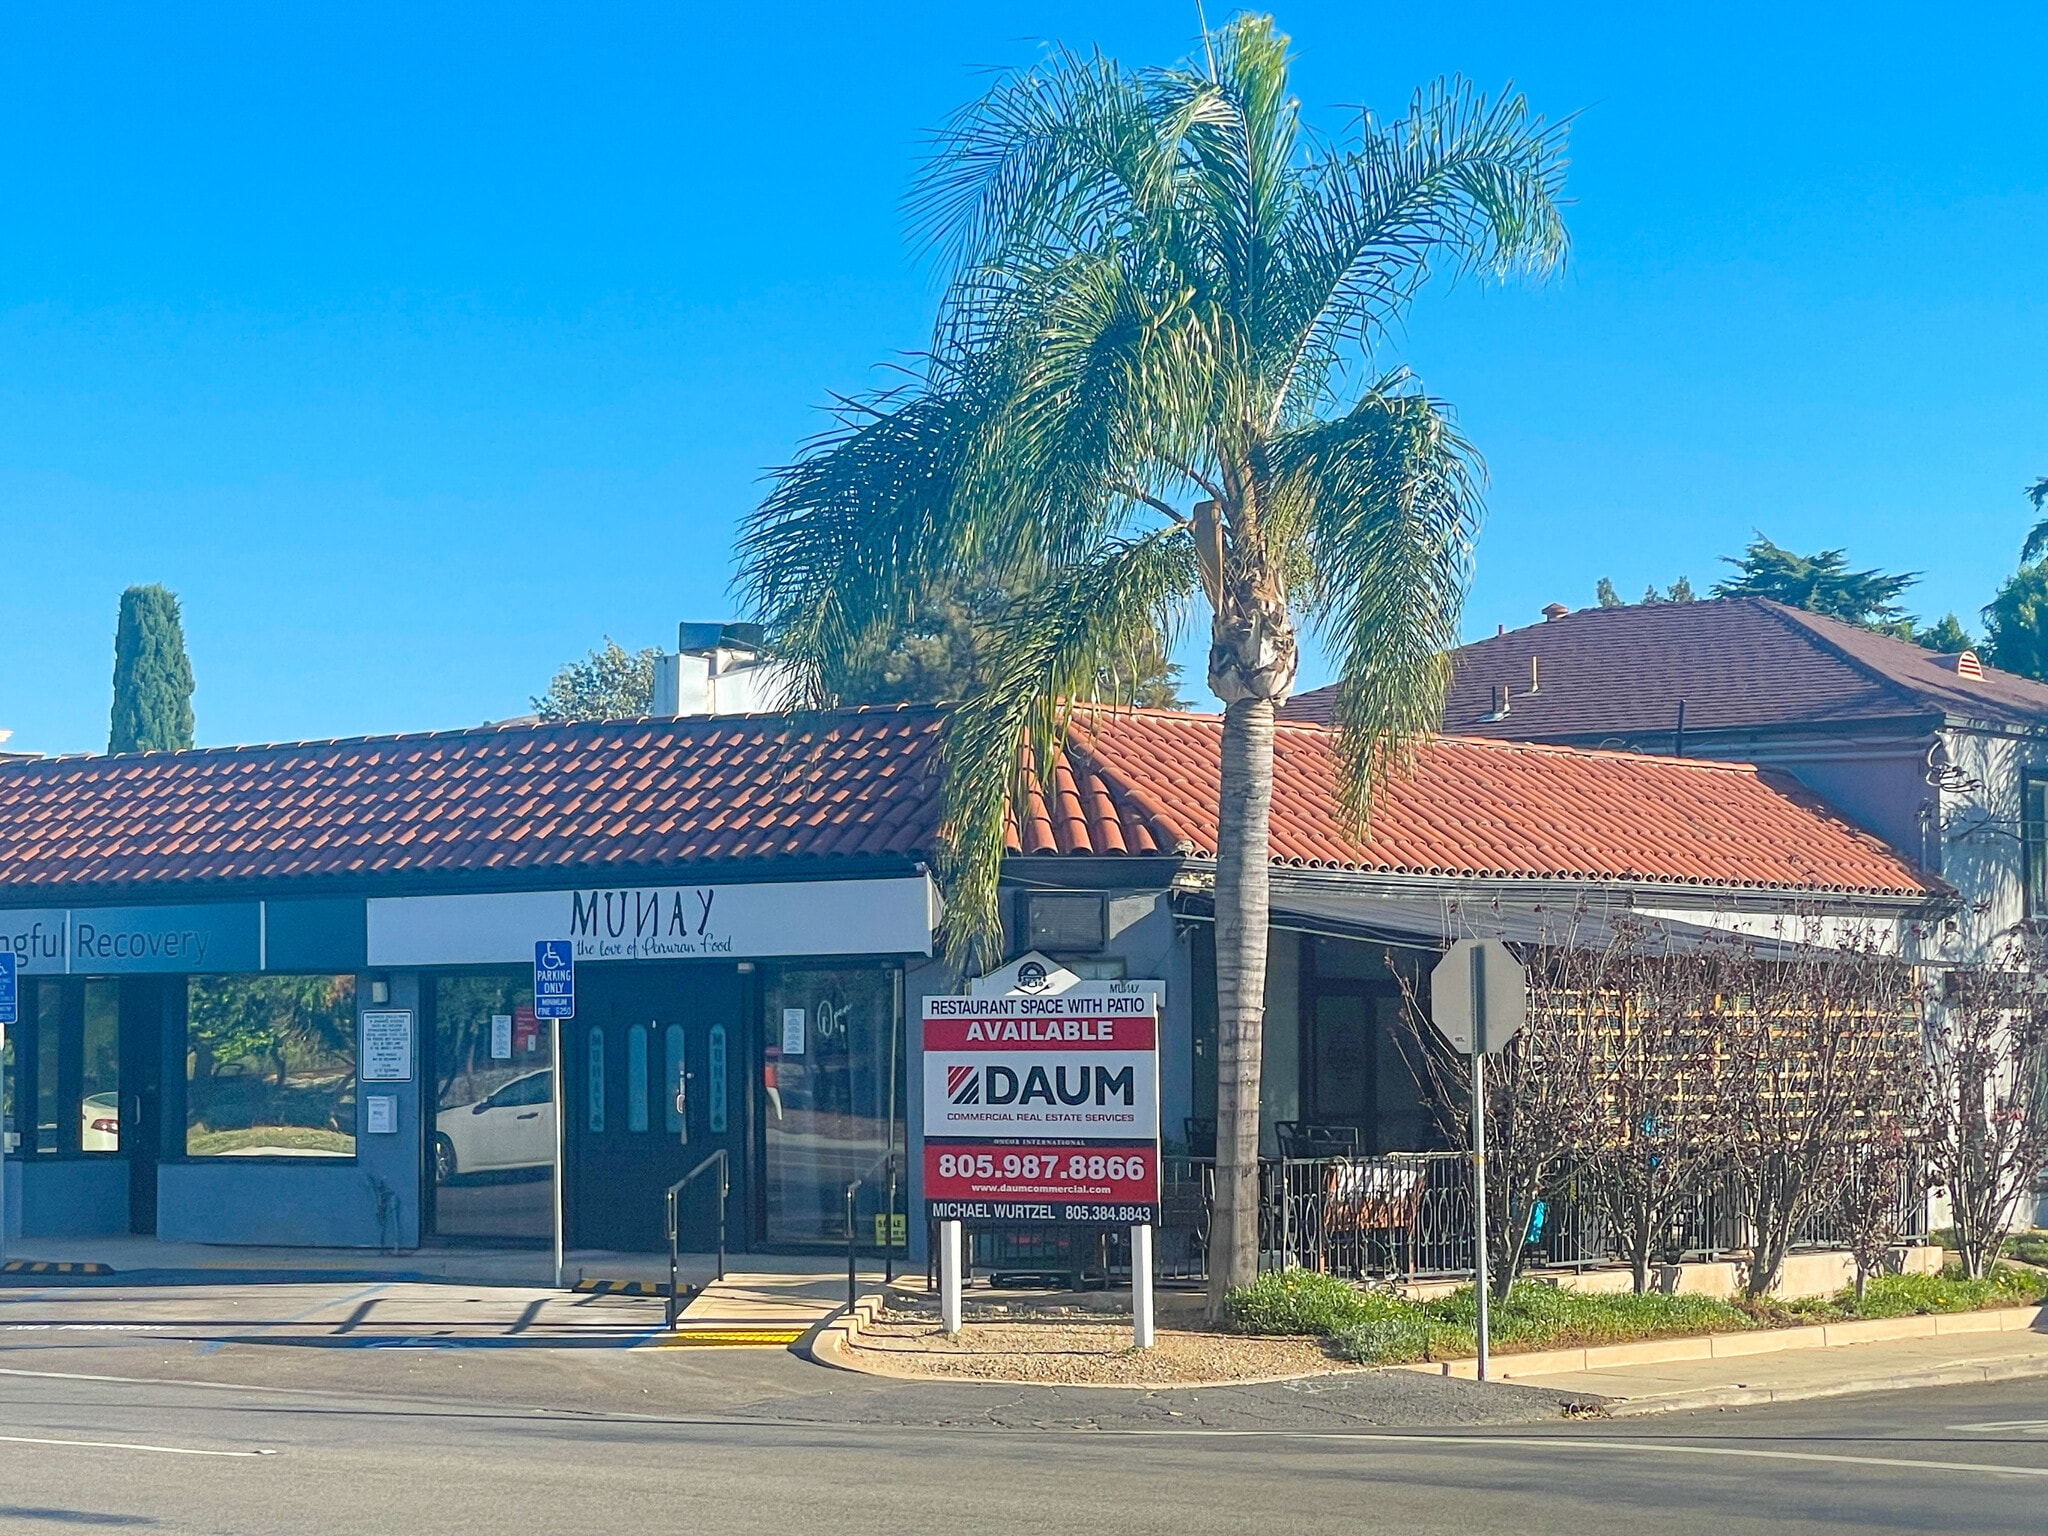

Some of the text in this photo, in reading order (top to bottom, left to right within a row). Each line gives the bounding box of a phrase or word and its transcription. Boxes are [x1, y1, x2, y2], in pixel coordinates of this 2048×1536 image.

[570, 889, 714, 938] MUNAY
[78, 924, 210, 966] Recovery
[577, 940, 595, 956] the
[600, 940, 622, 957] love
[626, 937, 639, 959] of
[537, 970, 571, 981] PARKING
[544, 982, 564, 994] ONLY
[538, 1007, 551, 1015] FINE
[931, 997, 1145, 1015] RESTAURANT SPACE WITH PATIO
[966, 1021, 1114, 1041] AVAILABLE
[986, 1066, 1134, 1106] DAUM
[947, 1112, 1135, 1122] COMMERCIAL REAL ESTATE SERVICES
[1022, 1138, 1086, 1146] INTERNATIONAL
[938, 1154, 1145, 1180] 805.987.8866
[971, 1183, 1112, 1194] www.daumcommercial.com
[932, 1203, 1151, 1221] MICHAEL WURTZEL 805.384.8843
